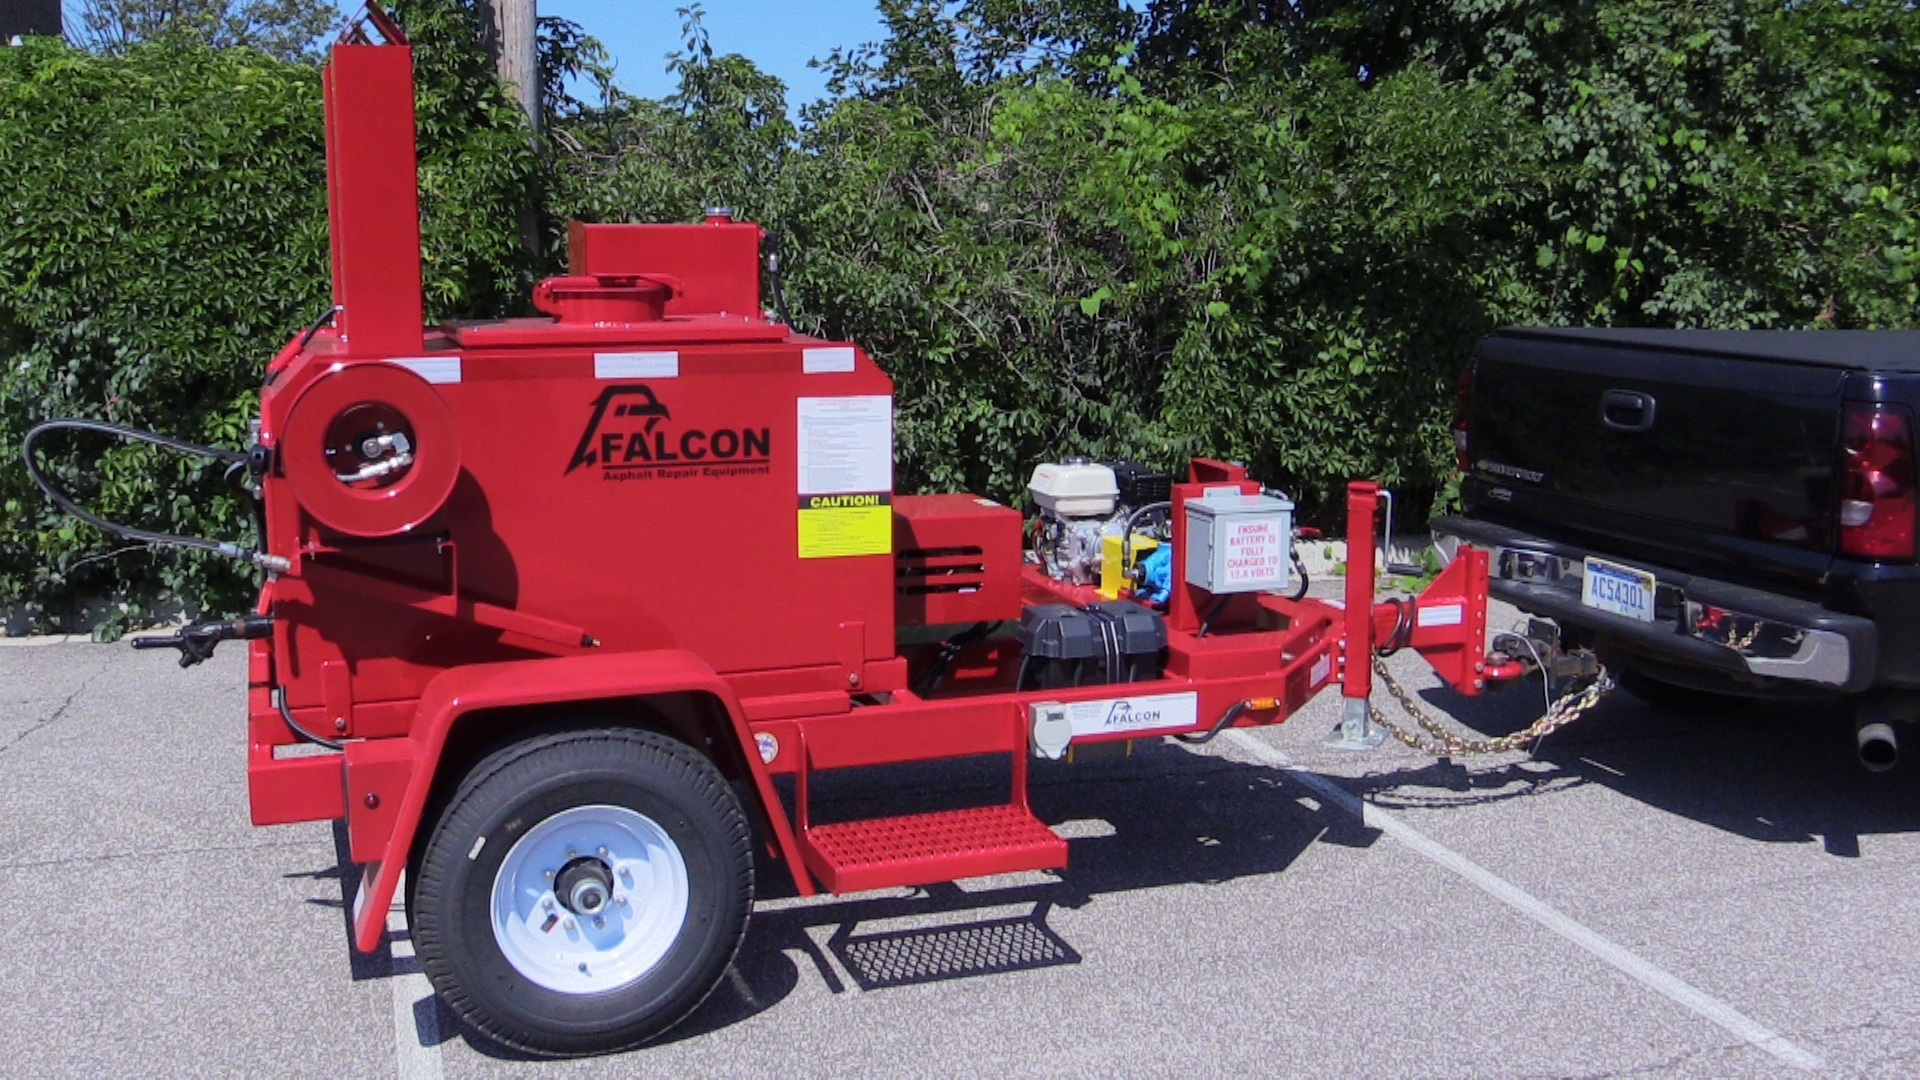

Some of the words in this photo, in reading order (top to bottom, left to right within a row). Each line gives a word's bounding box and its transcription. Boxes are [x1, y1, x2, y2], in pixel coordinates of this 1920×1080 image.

[601, 428, 770, 463] FALCON
[603, 471, 652, 482] Asphalt
[657, 468, 698, 480] Repair
[702, 465, 770, 478] Equipment
[810, 494, 880, 508] CAUTION!
[1238, 524, 1268, 534] ENSURE
[1230, 536, 1265, 546] BATTERY
[1269, 533, 1276, 543] IS
[1241, 547, 1264, 556] FULLY
[1227, 558, 1265, 568] CHARGED
[1268, 555, 1278, 565] TO
[1250, 568, 1274, 577] VOLTS
[1591, 575, 1645, 610] AC54301
[1113, 711, 1160, 724] FALCON
